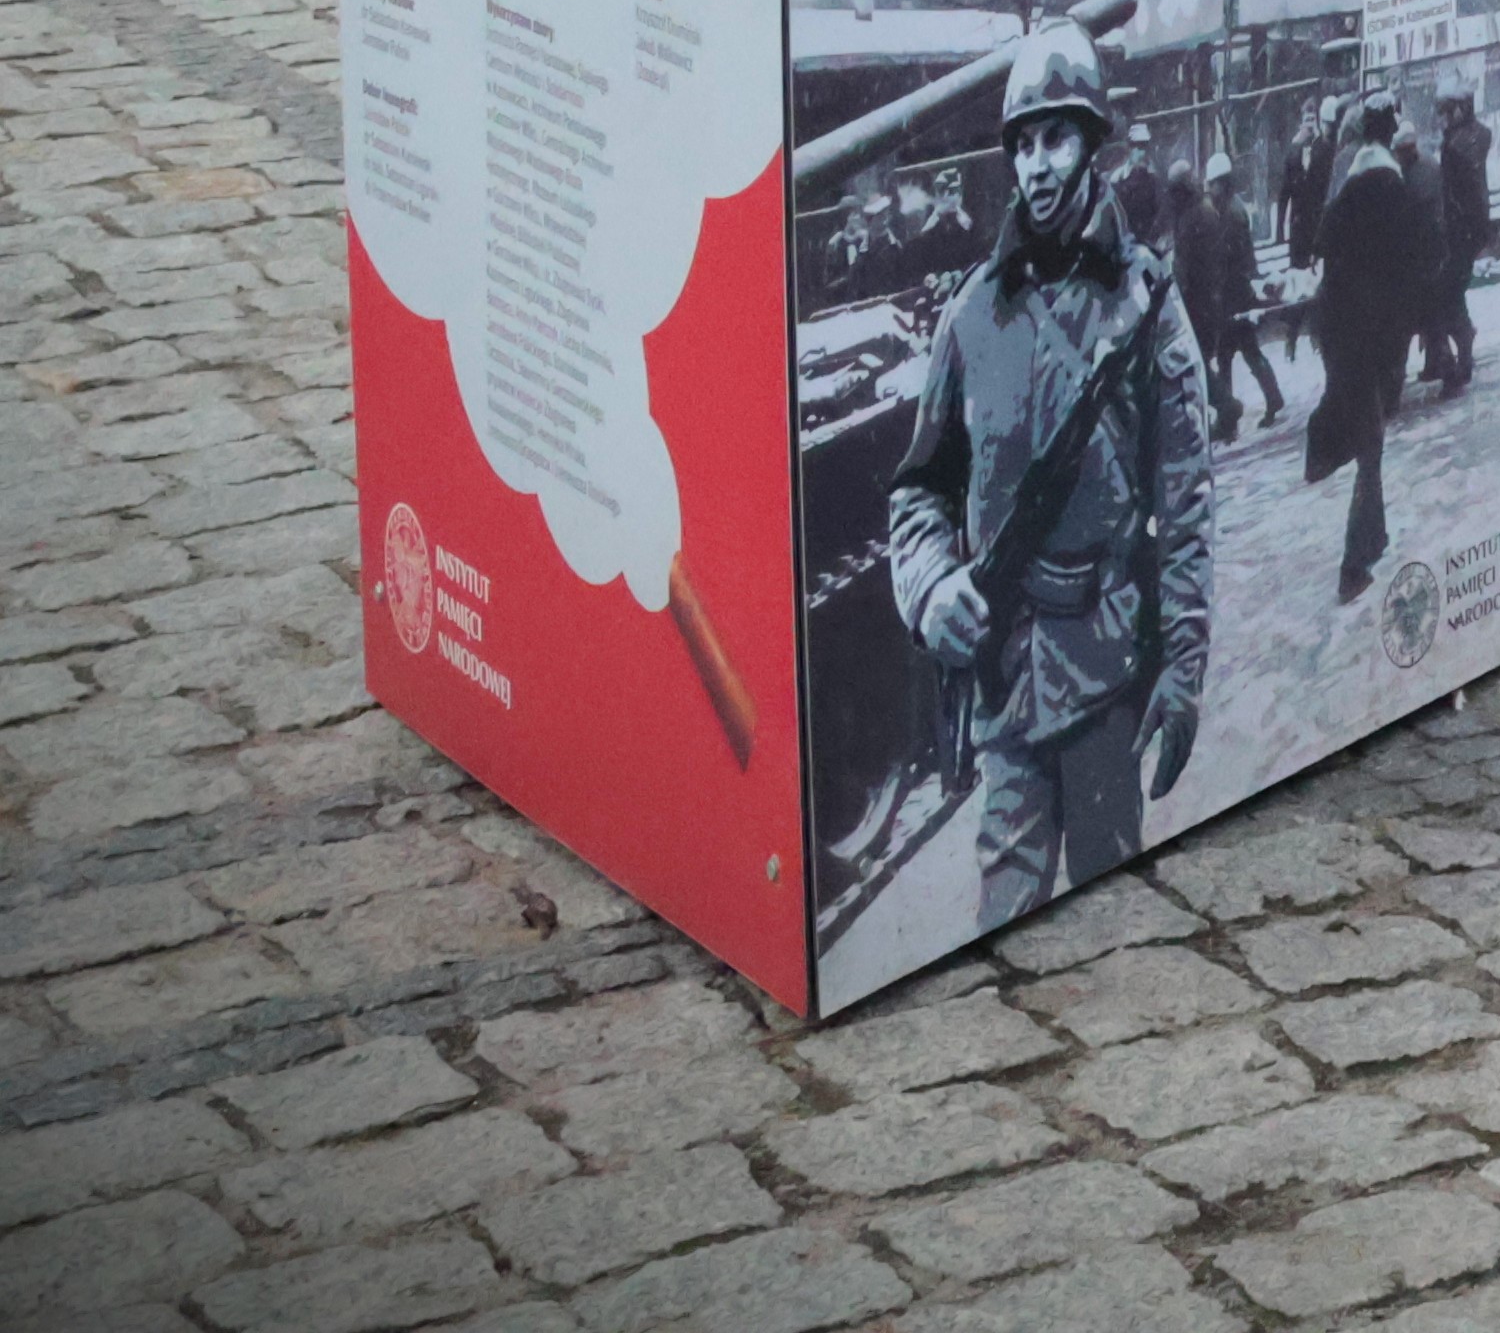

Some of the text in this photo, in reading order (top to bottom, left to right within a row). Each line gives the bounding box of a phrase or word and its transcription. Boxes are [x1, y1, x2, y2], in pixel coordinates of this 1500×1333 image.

[436, 546, 490, 602] INSTYTUT
[437, 588, 481, 641] PAMIĘCI
[438, 632, 510, 709] NARODOWEJ
